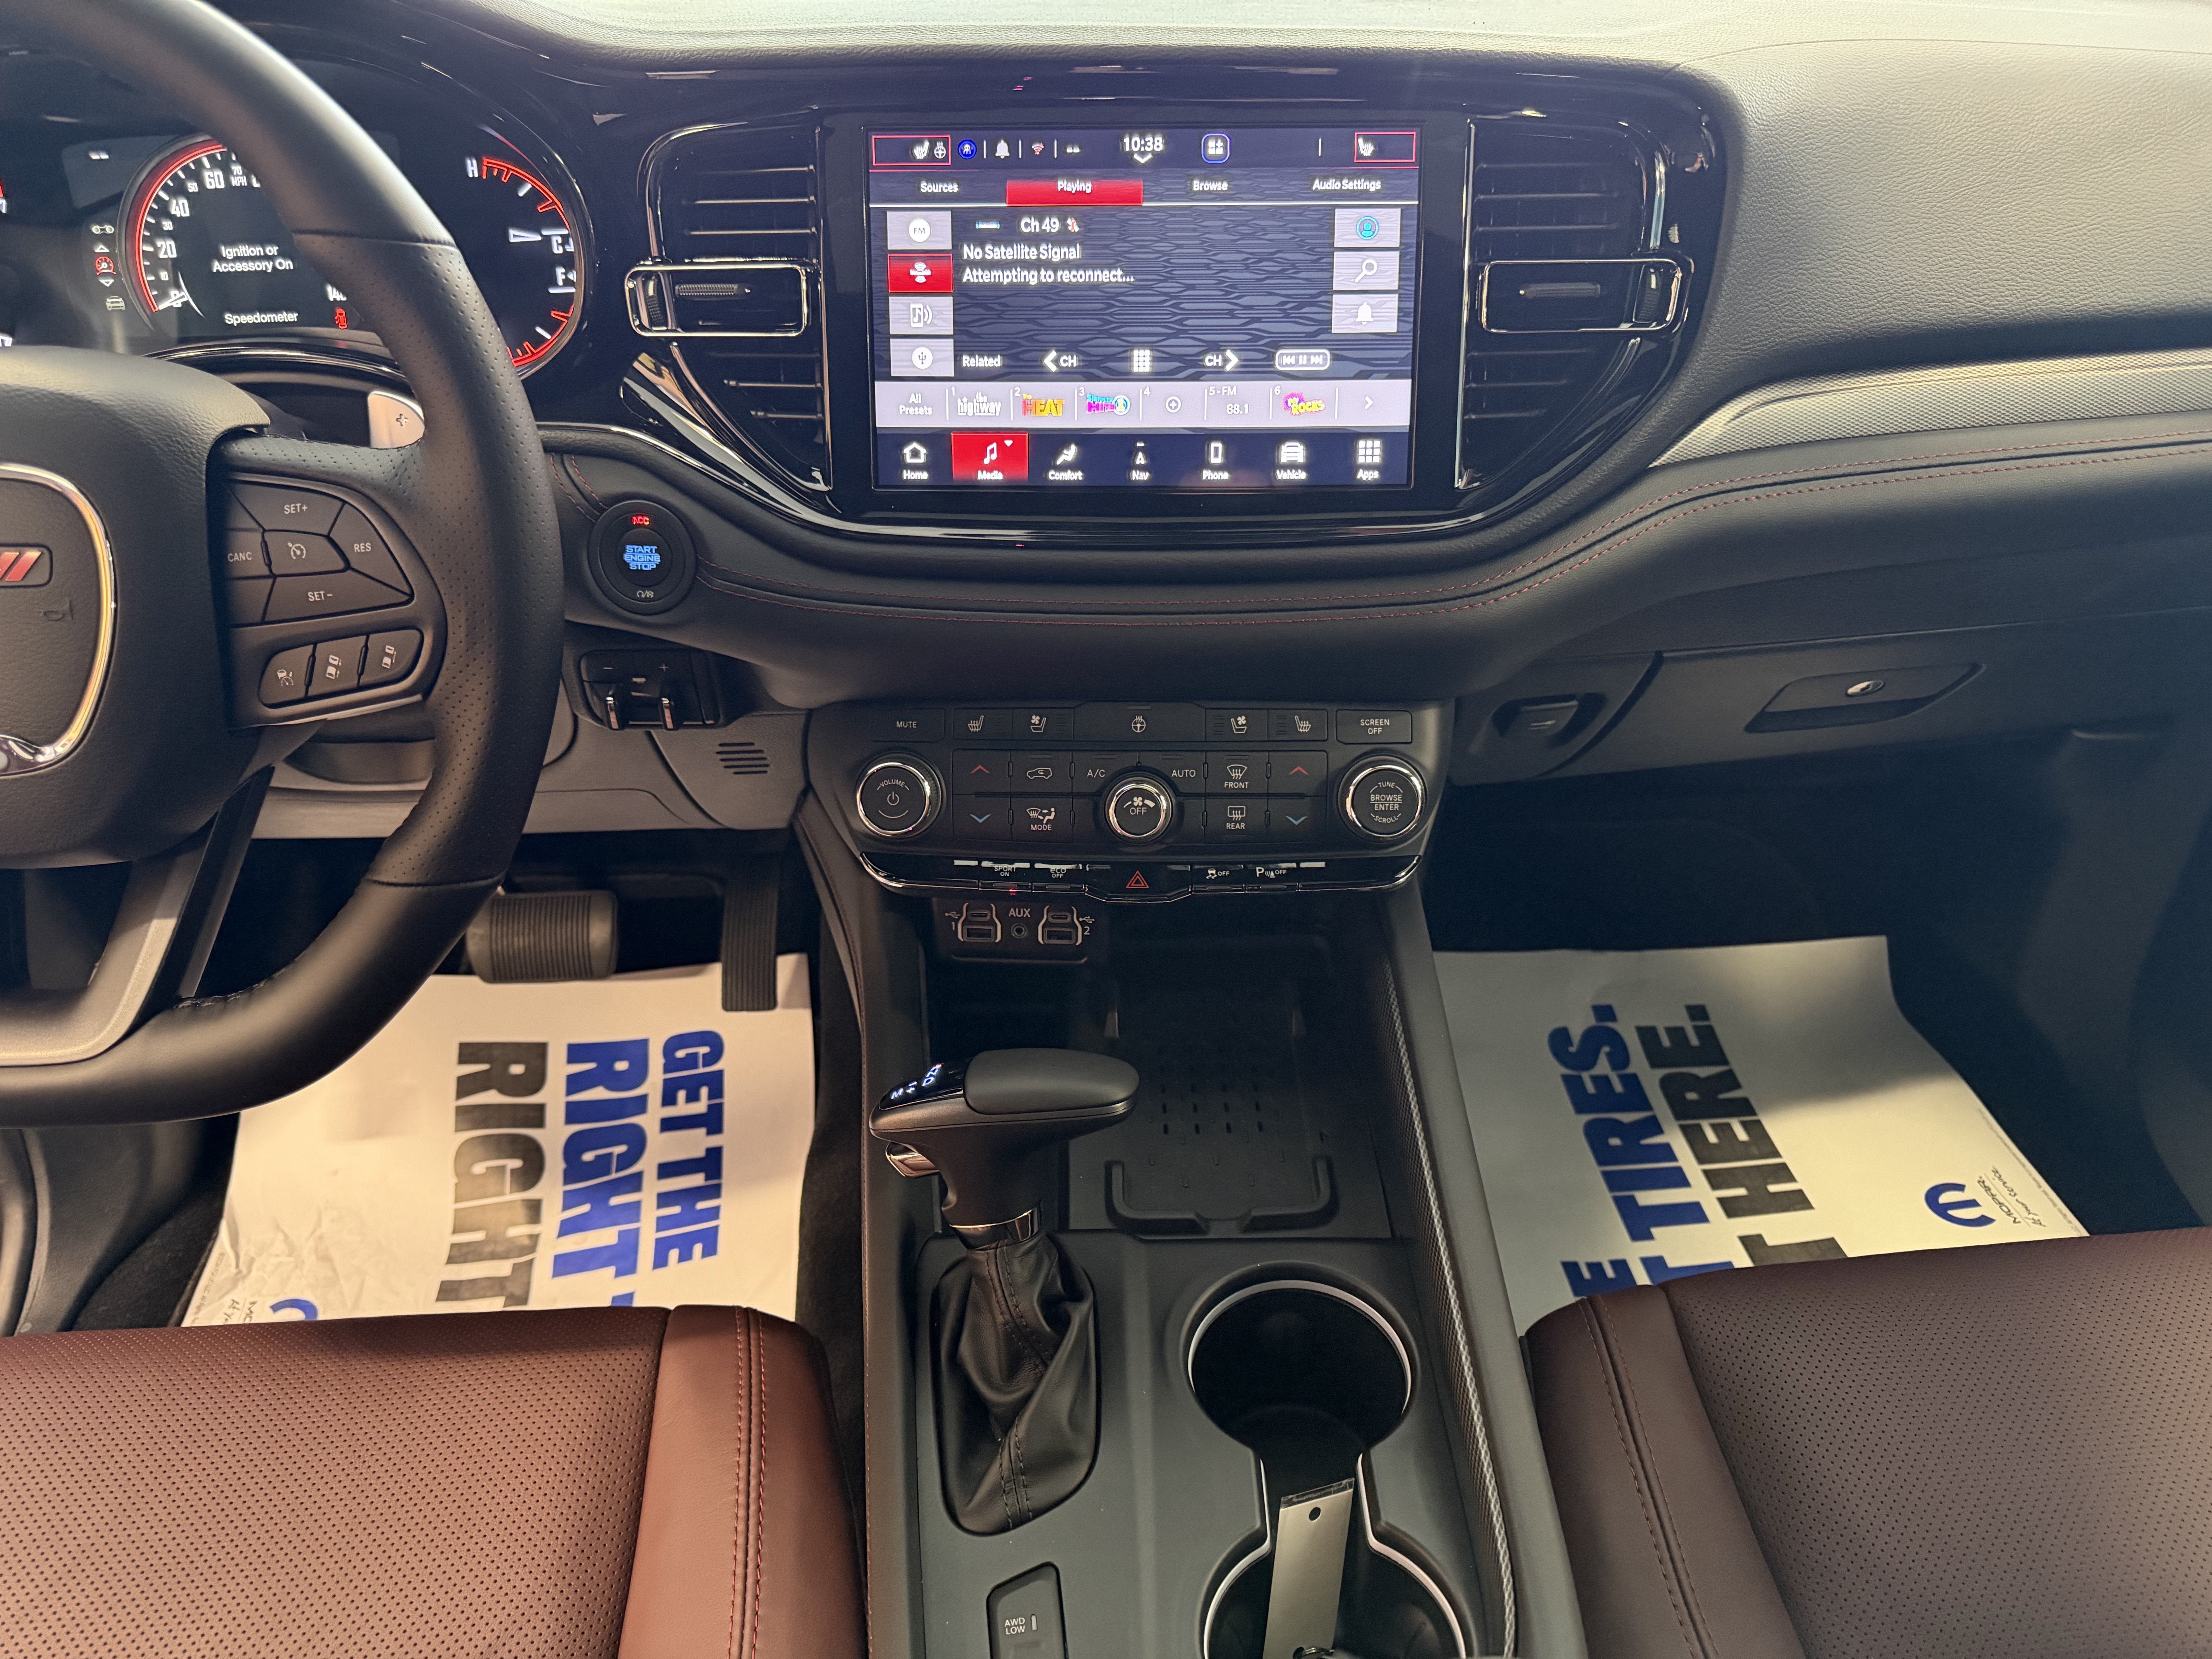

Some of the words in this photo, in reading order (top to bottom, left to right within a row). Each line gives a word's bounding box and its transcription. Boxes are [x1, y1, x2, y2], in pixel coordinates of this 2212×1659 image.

[1124, 135, 1163, 151] 10:38
[232, 166, 242, 175] 70
[466, 157, 478, 177] H
[205, 172, 225, 189] 60
[231, 176, 247, 186] MPH
[1193, 180, 1228, 191] Browse
[1313, 179, 1340, 190] Audio
[1342, 179, 1381, 191] Settings
[188, 183, 198, 192] 50
[921, 181, 958, 193] Sources
[1058, 179, 1092, 193] Playing
[171, 199, 190, 217] 40
[162, 221, 173, 230] 30
[1021, 216, 1039, 232] Ch
[1042, 216, 1059, 232] 49
[157, 240, 177, 258] 20
[551, 235, 563, 254] C
[222, 245, 264, 259] Ignition
[266, 246, 278, 256] or
[963, 245, 982, 259] No
[985, 244, 1037, 259] Satellite
[1039, 243, 1080, 262] Signal
[213, 260, 272, 272] Accessory
[276, 259, 293, 270] On
[160, 271, 168, 281] 10
[556, 267, 565, 286] F
[963, 268, 1038, 285] Attempting
[1040, 269, 1054, 282] to
[1057, 268, 1134, 282] reconnect...
[225, 312, 298, 326] Speedometer
[962, 355, 1001, 368] Related
[1060, 356, 1077, 367] CH
[1205, 355, 1222, 366] CH
[951, 386, 955, 396] 1
[1015, 387, 1021, 396] 2
[1079, 386, 1085, 396] 3
[1144, 386, 1151, 396] 4
[1274, 386, 1281, 395] 6
[909, 393, 922, 404] All
[899, 405, 933, 416] Presets
[957, 397, 1001, 416] highway
[1022, 399, 1065, 416] HEAT
[1226, 404, 1249, 414] 88.1
[903, 471, 928, 480] Home
[978, 470, 1003, 480] Media
[1049, 470, 1082, 480] Comfort
[1132, 470, 1149, 480] Nav
[1202, 470, 1228, 480] Phone
[1276, 470, 1306, 480] Vehicle
[1357, 470, 1378, 480] Apps
[632, 516, 650, 525] ACC
[354, 543, 371, 552] RES
[626, 545, 657, 554] START
[228, 552, 252, 562] CANC
[1087, 769, 1105, 778] A/C
[1171, 769, 1196, 778] AUTO
[879, 779, 906, 788] VOLUME
[1370, 794, 1402, 802] BROWSE
[1129, 807, 1147, 815] OFF
[1374, 803, 1399, 811] ENTER
[1374, 815, 1399, 824] SCROLL
[1008, 908, 1031, 918] AUX
[951, 922, 955, 931] 1
[1084, 926, 1090, 935] 2
[659, 1029, 725, 1135] GET
[1635, 1004, 1815, 1219] HERE.
[1548, 1005, 1710, 1242] TIRES.
[551, 1038, 650, 1279] RIGHT
[435, 1042, 549, 1310] RIGHT
[652, 1145, 724, 1272] THE
[1005, 1617, 1025, 1627] AWD
[1006, 1626, 1025, 1635] LOW
